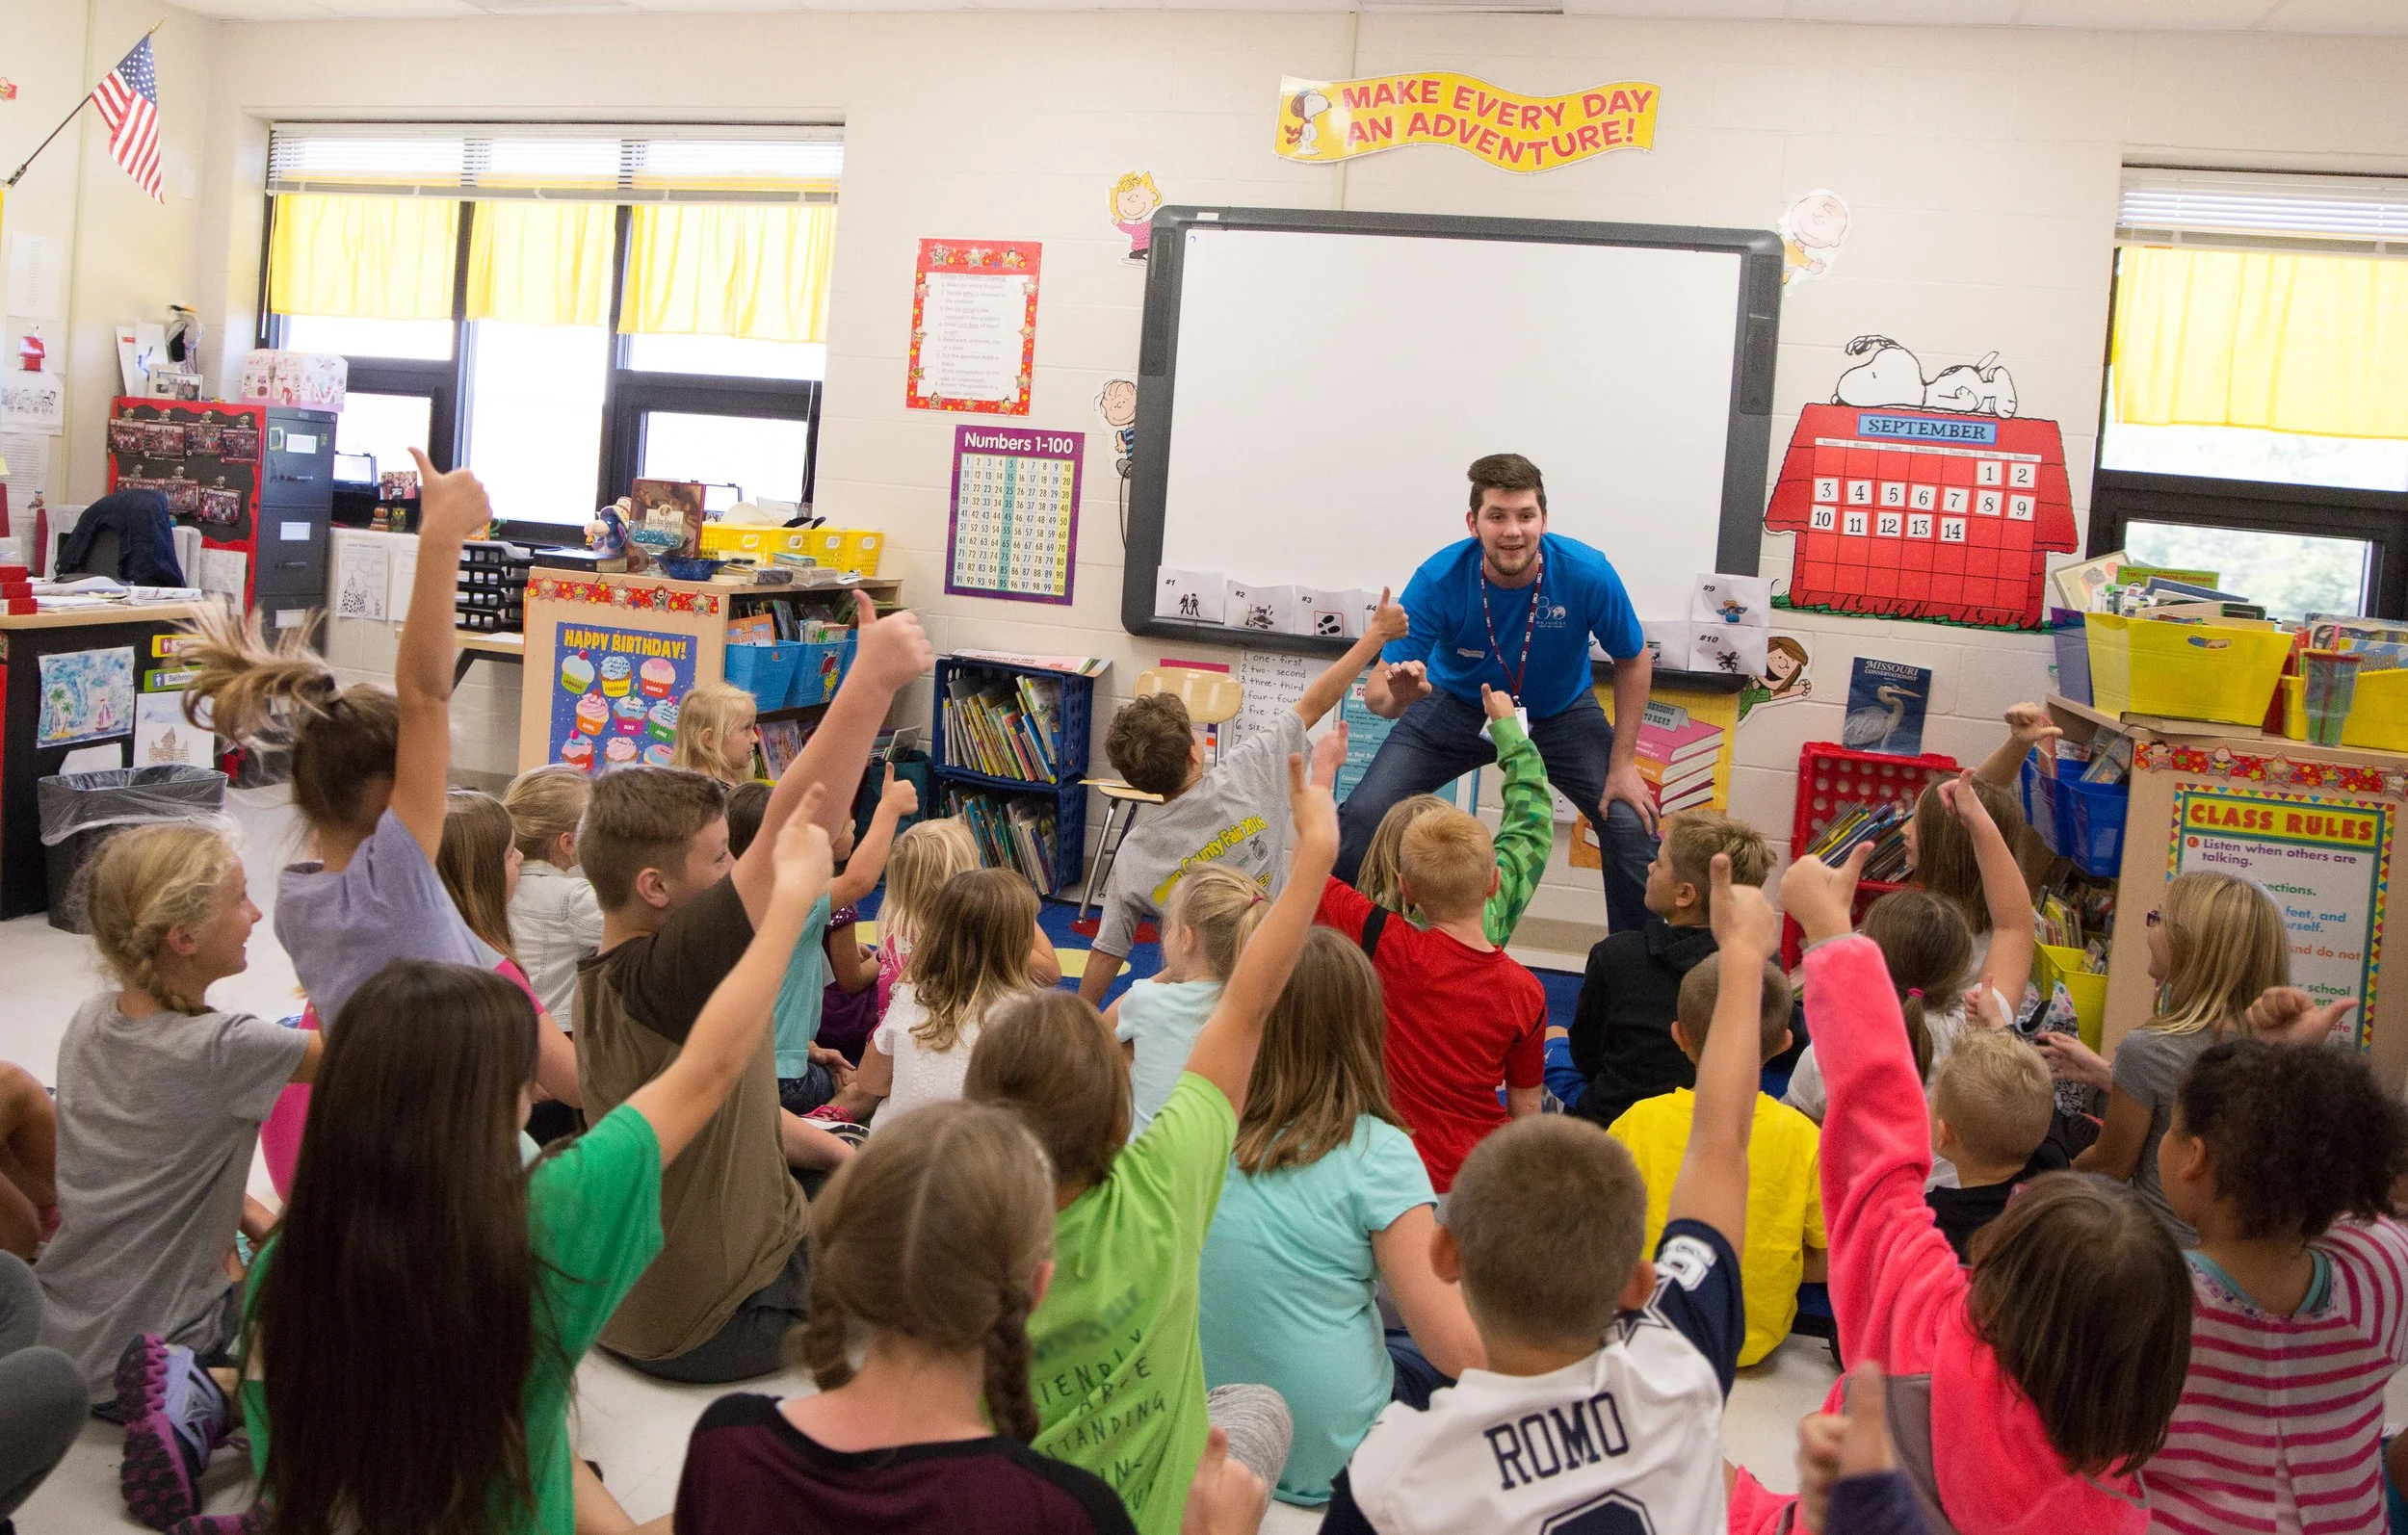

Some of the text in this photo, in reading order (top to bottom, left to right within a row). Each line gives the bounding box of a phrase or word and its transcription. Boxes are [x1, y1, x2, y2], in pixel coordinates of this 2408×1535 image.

[1342, 80, 1652, 131] MAKE EVERY DAY
[1348, 112, 1635, 166] AN ADVENTURE!
[1869, 419, 1985, 439] SEPTEMBER
[965, 432, 1073, 454] Numbers 1-100
[1062, 477, 1071, 485] 20
[1987, 466, 2028, 483] 1 2
[1822, 482, 2026, 516] 3 4 5 6 7 8 9
[1816, 512, 1961, 538] 10 11 12 13 14
[1010, 580, 1017, 588] 96
[1054, 584, 1064, 593] 100
[1235, 590, 1245, 599] #2
[564, 629, 687, 661] HAPPY BIRTHDAY!
[1699, 635, 1718, 643] #10
[1280, 655, 1302, 666] first
[1865, 661, 1919, 676] MISSOURI
[1865, 669, 1917, 681] CONSERVATIONIST
[1280, 682, 1303, 691] third
[1653, 715, 1670, 726] READ
[1219, 824, 1245, 847] Fair
[1241, 814, 1268, 836] 2016
[2190, 803, 2374, 841] CLASS RULES
[2202, 852, 2253, 868] talking.
[2203, 839, 2240, 852] Listen
[2246, 845, 2283, 856] when
[2287, 849, 2329, 862] others
[2334, 854, 2357, 864] are
[2285, 906, 2347, 923] feet, and
[2316, 947, 2334, 957] do
[2339, 950, 2361, 961] not
[2308, 982, 2350, 997] school
[1483, 1392, 1630, 1491] ROMO
